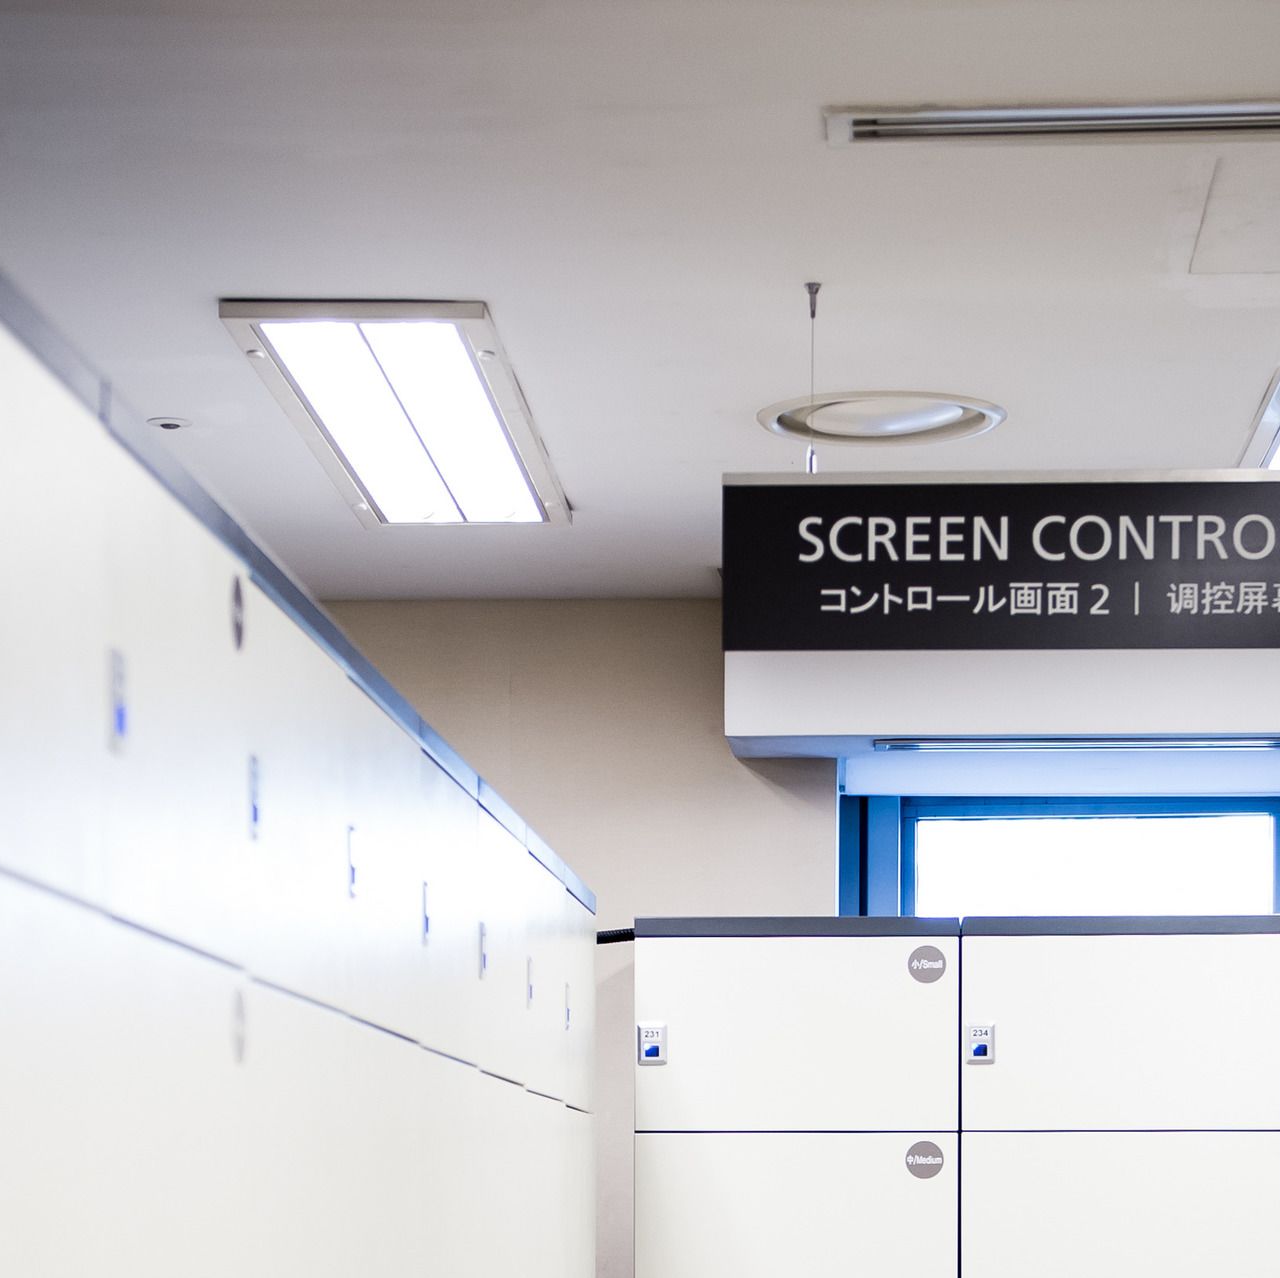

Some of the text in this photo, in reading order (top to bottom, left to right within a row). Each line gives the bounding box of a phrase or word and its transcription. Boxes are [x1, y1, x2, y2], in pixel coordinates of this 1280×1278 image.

[798, 513, 1009, 562] SCREEN
[644, 1030, 659, 1038] 231
[973, 1029, 988, 1037] 234
